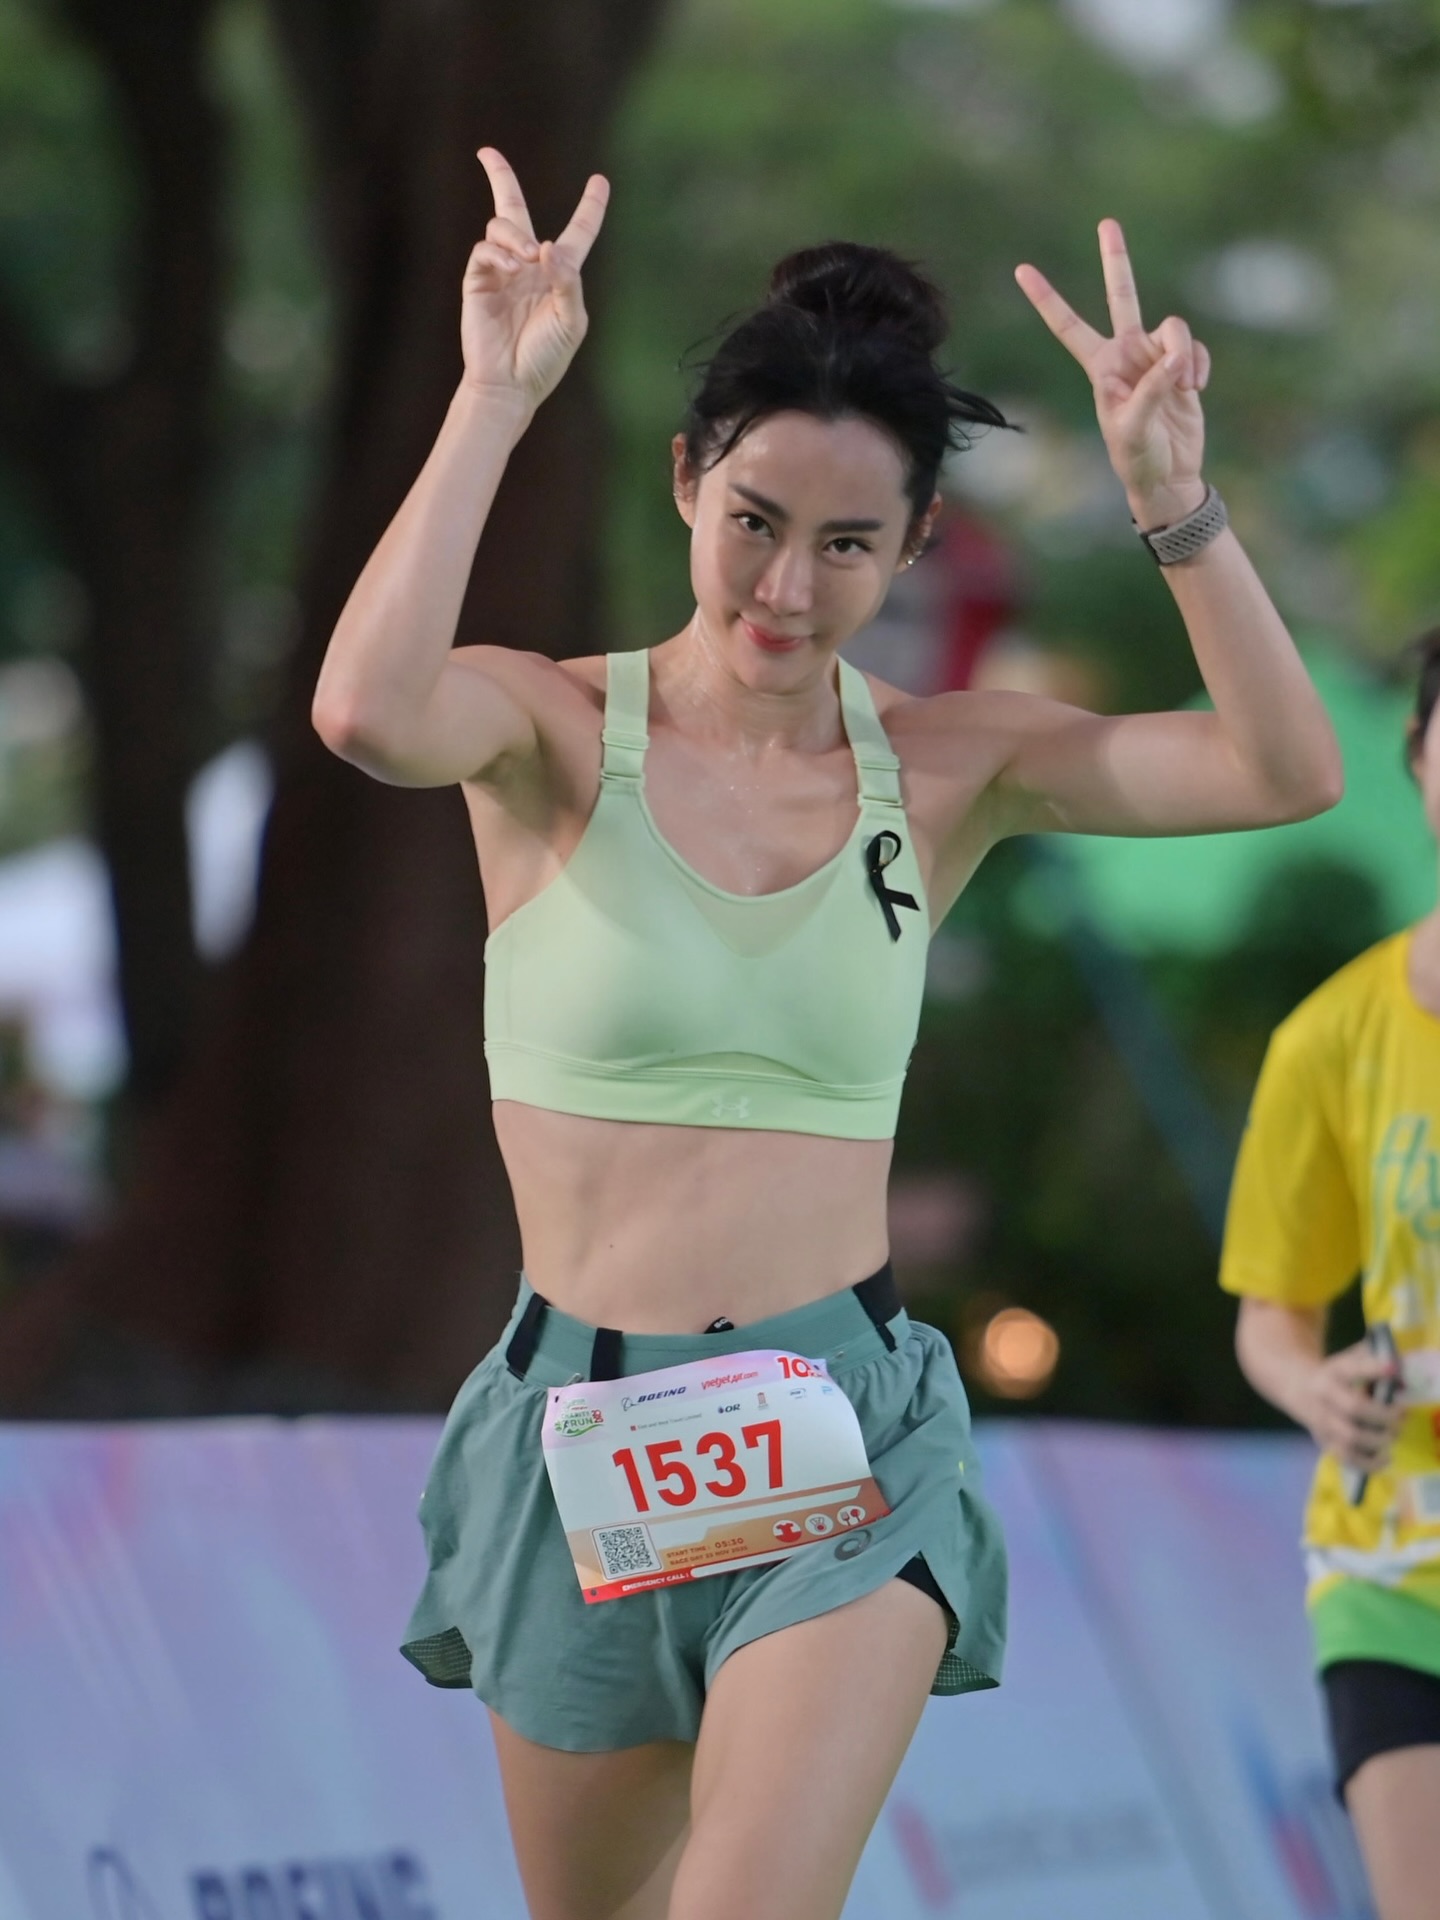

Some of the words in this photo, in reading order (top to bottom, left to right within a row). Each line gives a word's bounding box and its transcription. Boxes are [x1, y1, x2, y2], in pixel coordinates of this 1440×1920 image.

[777, 1356, 811, 1379] 10
[638, 1386, 687, 1403] BOEING
[725, 1403, 741, 1413] OR
[570, 1417, 594, 1427] RUN
[612, 1419, 783, 1513] 1537
[666, 1549, 688, 1558] START
[715, 1537, 744, 1548] 05:30
[670, 1557, 688, 1565] RACE
[622, 1577, 665, 1592] EMERGENCY
[667, 1573, 686, 1582] CALL
